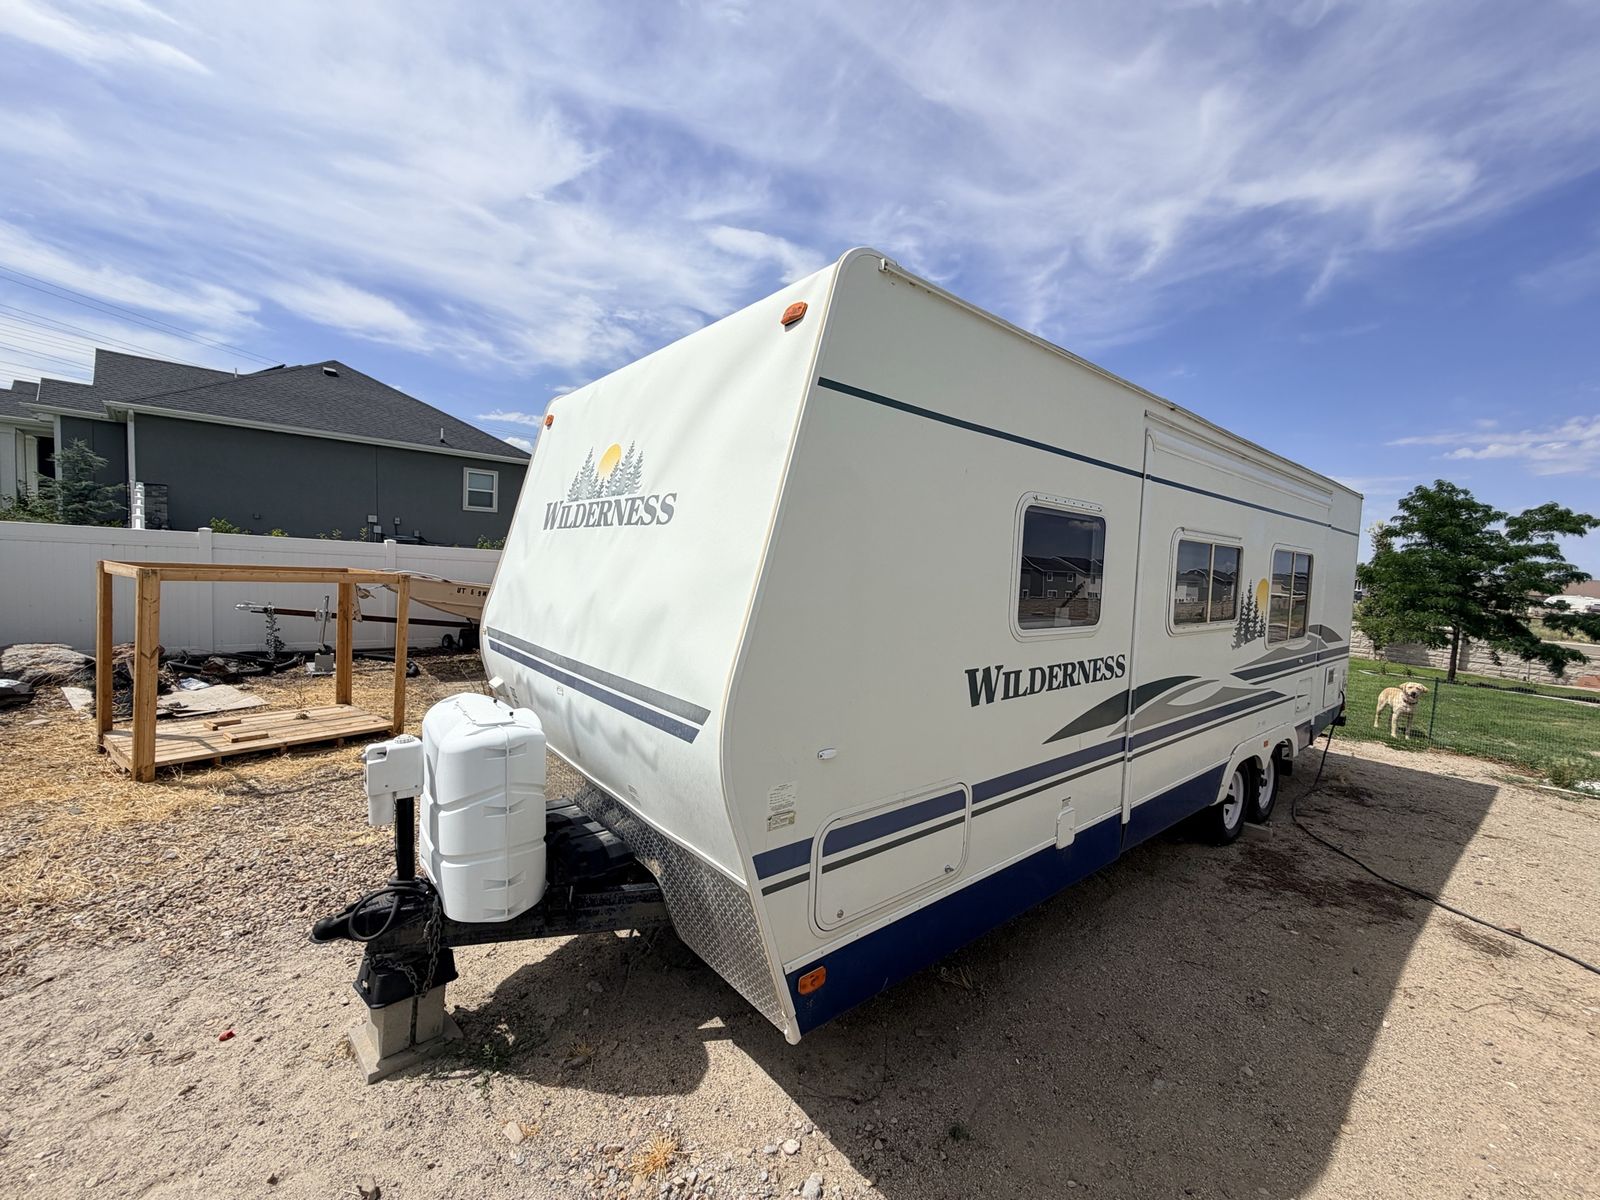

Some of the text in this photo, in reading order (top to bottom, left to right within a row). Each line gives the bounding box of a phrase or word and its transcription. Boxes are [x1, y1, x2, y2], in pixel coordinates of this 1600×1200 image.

[543, 492, 677, 531] WILDERNESS
[457, 587, 466, 595] UT
[964, 653, 1126, 708] WILDERNESS
